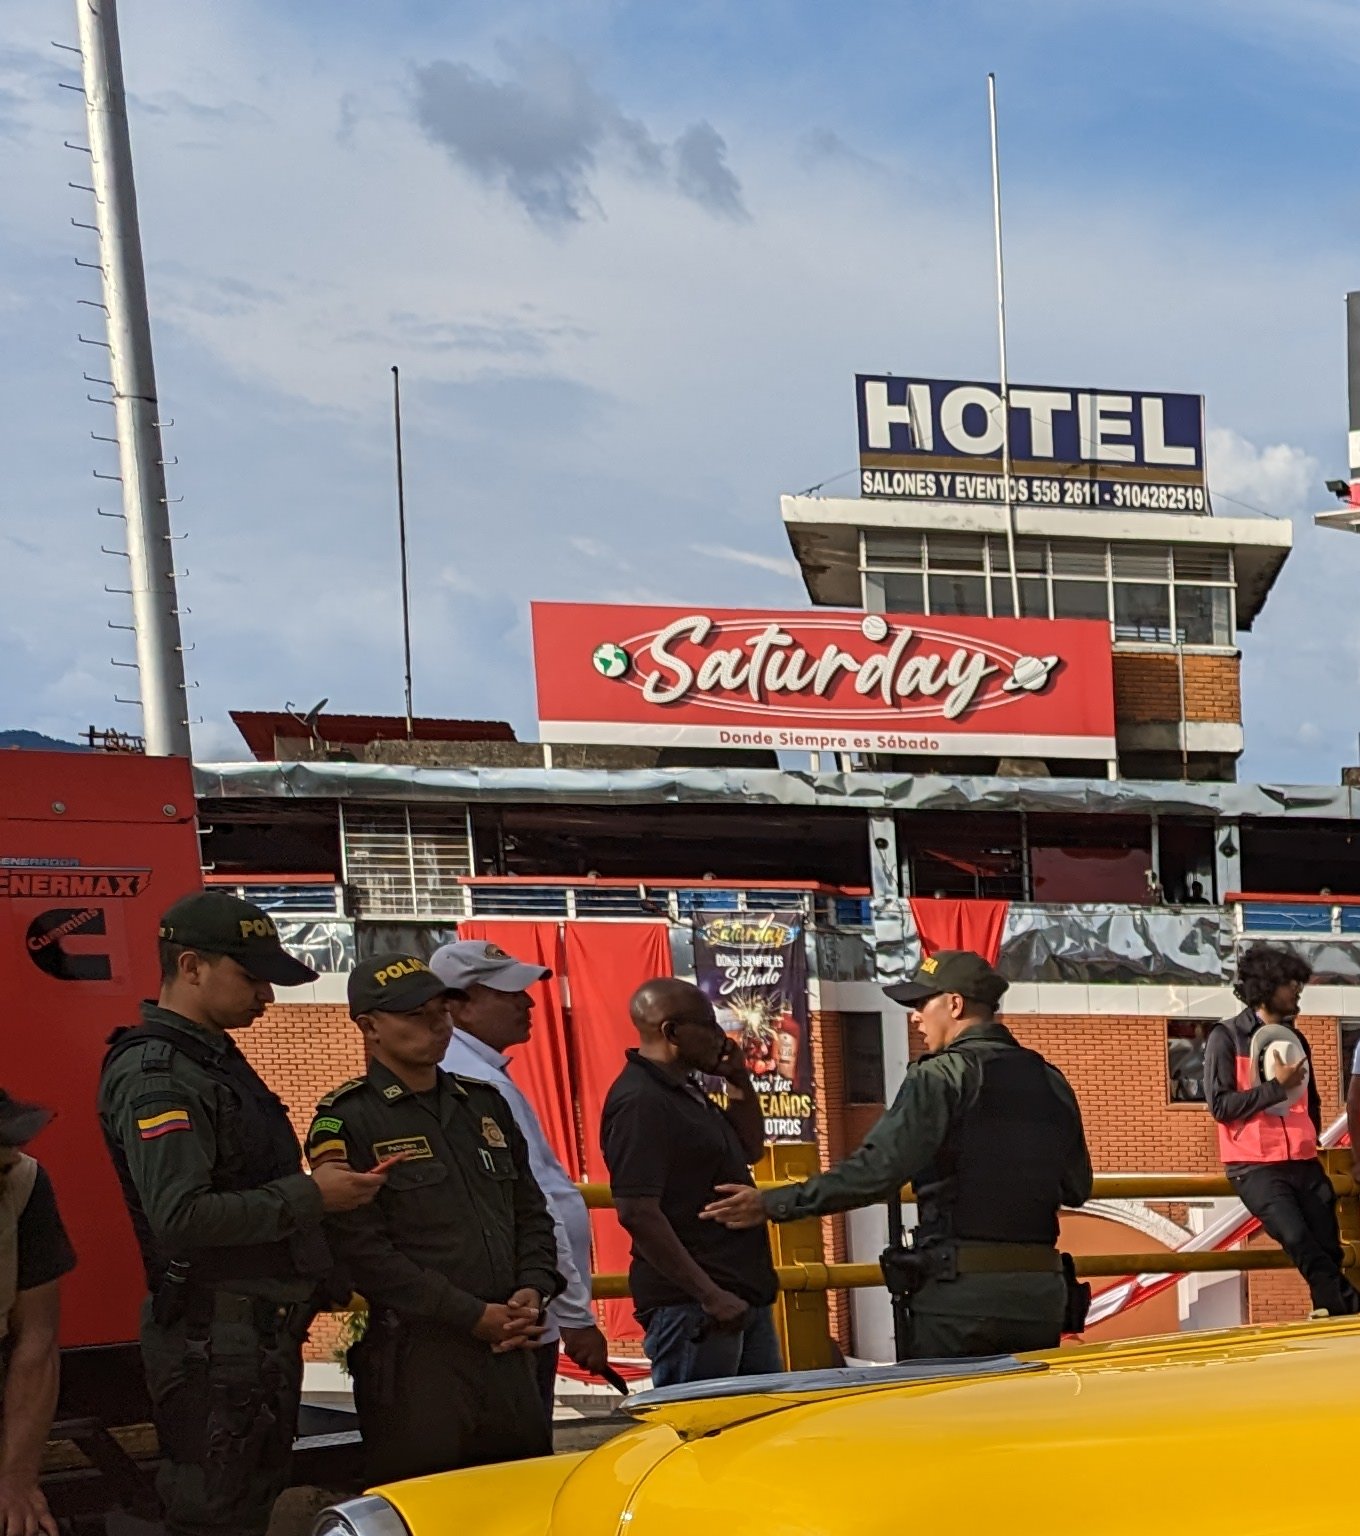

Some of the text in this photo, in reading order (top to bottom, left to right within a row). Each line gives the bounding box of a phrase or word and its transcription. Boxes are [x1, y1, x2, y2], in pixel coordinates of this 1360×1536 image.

[864, 380, 1197, 466] HOTEL
[862, 472, 937, 498] SALONES
[940, 475, 951, 497] Y
[955, 475, 1028, 501] EVENTOS
[1032, 479, 1061, 503] 558
[1064, 481, 1100, 505] 2611
[1113, 484, 1204, 510] 3104282519
[642, 615, 1000, 720] Saturday
[720, 731, 939, 750] Donde Siempre es Sábado
[0, 857, 80, 867] ENERADOR
[764, 1118, 801, 1135] OTROS
